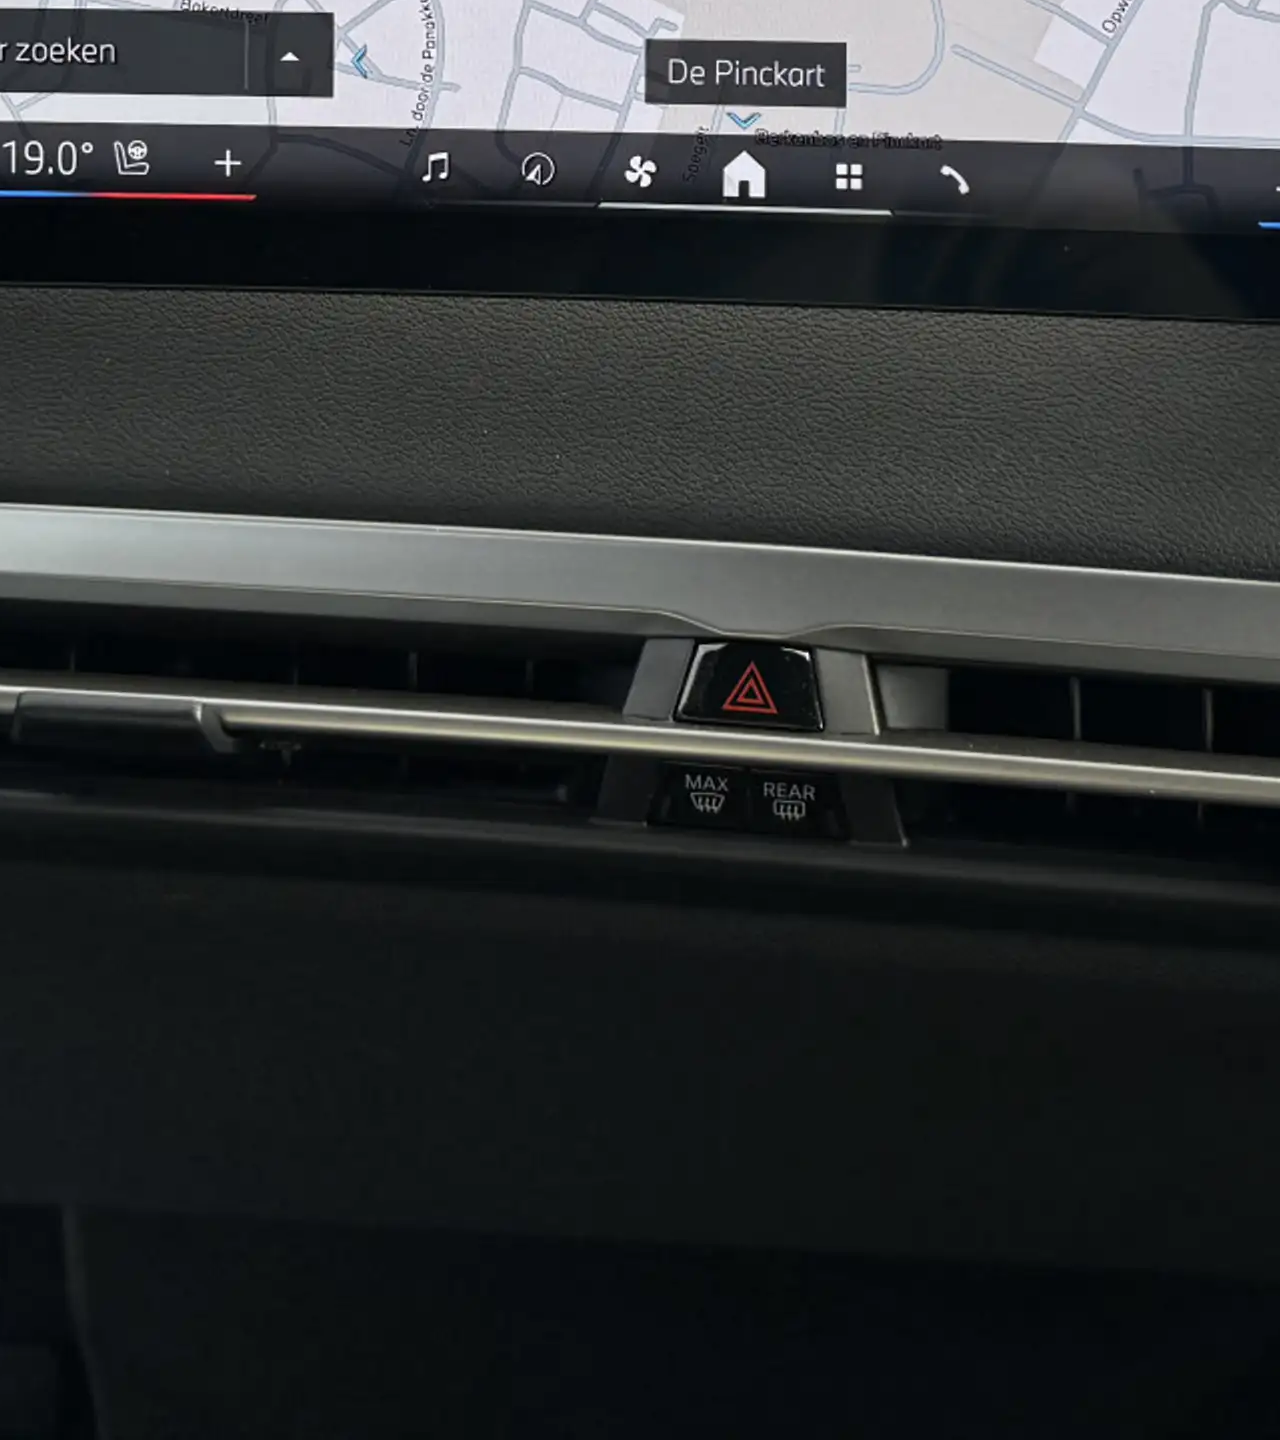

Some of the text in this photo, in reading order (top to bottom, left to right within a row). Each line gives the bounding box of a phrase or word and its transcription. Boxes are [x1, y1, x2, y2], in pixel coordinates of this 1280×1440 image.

[15, 37, 117, 64] zoeken
[668, 58, 827, 88] De Pinckart
[1, 139, 95, 177] 19.0°
[684, 773, 729, 792] MAX
[763, 781, 816, 801] REAR
